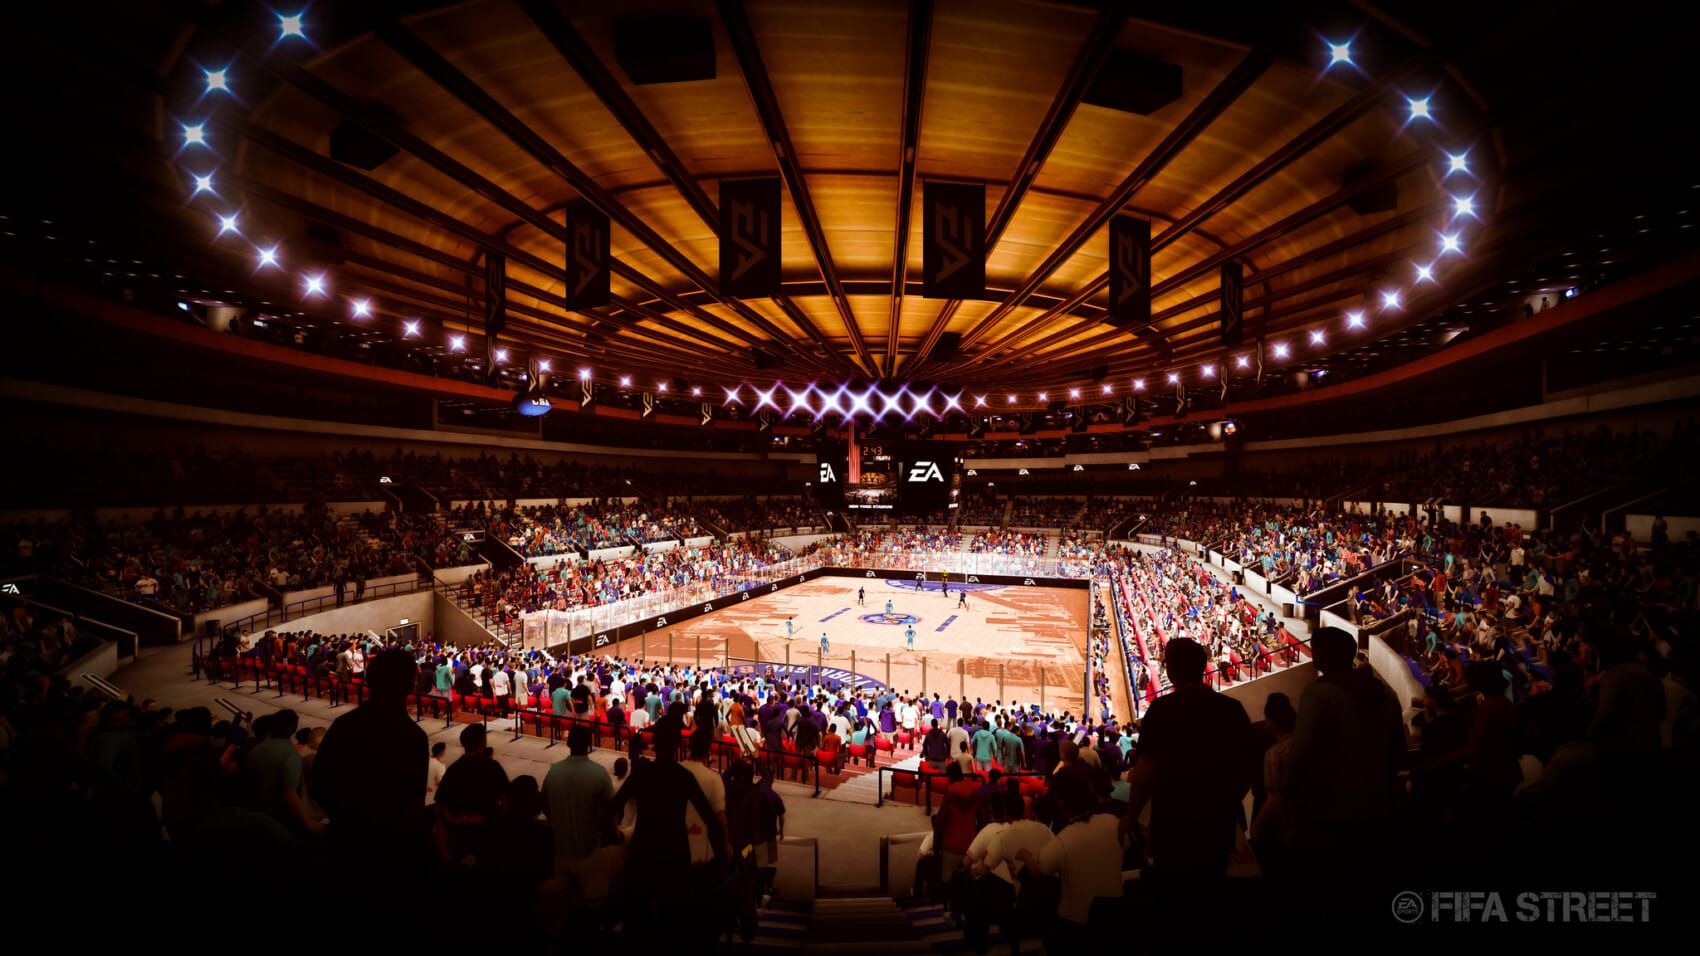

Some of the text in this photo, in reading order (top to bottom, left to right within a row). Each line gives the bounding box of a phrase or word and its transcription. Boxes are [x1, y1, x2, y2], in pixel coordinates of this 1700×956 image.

[820, 463, 837, 483] EA
[908, 461, 944, 482] EA
[865, 570, 877, 578] EA
[968, 575, 980, 583] EA
[1024, 578, 1036, 586] EA
[703, 603, 713, 613] EA
[657, 616, 668, 628] EA
[596, 634, 610, 647] EA
